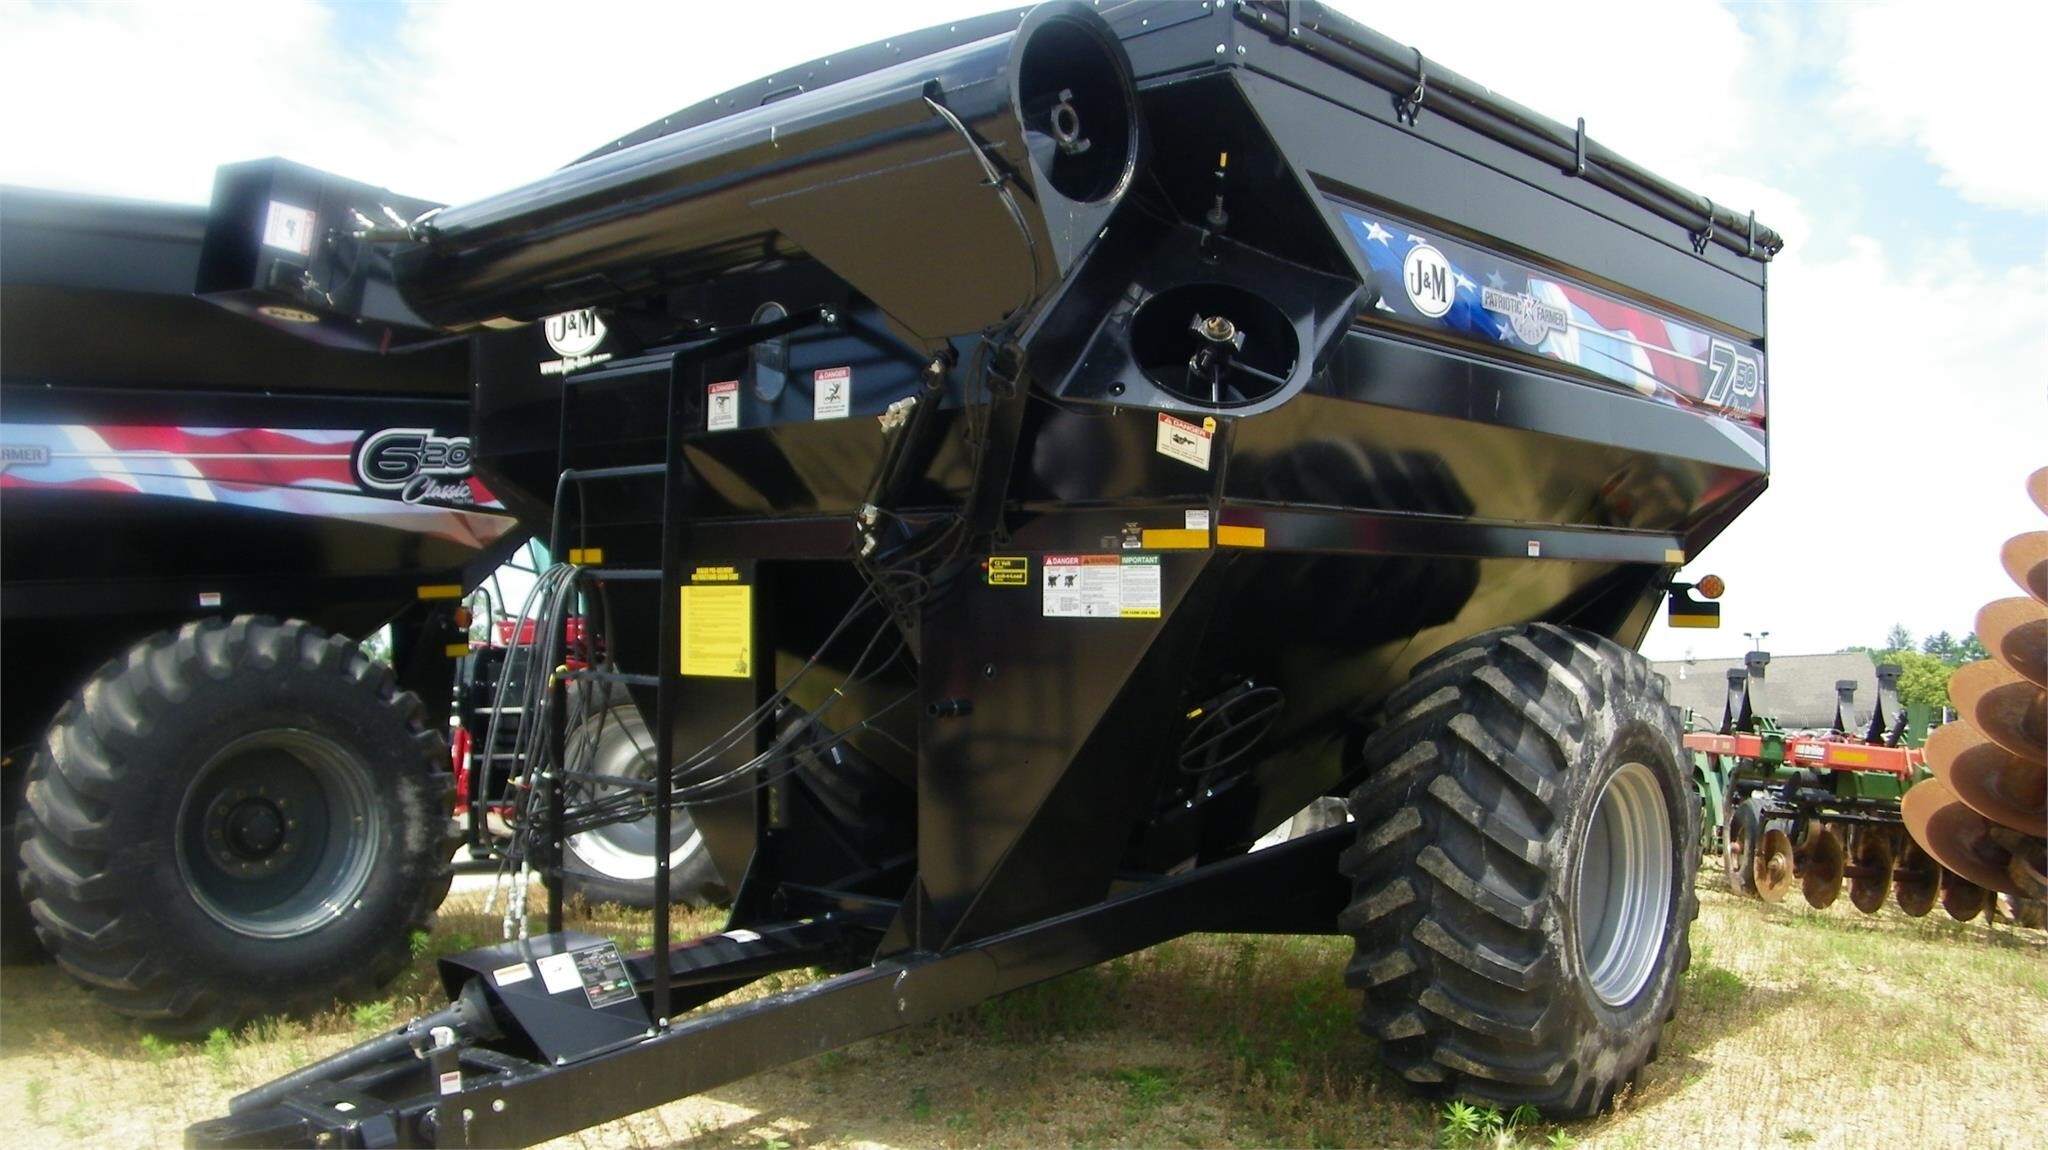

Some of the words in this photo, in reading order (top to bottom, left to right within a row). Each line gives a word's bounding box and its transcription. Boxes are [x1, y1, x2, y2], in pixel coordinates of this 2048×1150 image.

[1410, 259, 1447, 303] J&M
[1484, 290, 1523, 315] PATRIOTIC
[1536, 303, 1564, 327] FARMER
[552, 310, 596, 342] J&M
[824, 368, 847, 380] DANGER
[1703, 338, 1758, 405] 750
[1173, 420, 1206, 436] DANGER
[0, 448, 42, 461] RMER
[357, 427, 471, 490] 620
[402, 474, 471, 505] Classic
[1052, 556, 1079, 565] DANGER
[1121, 556, 1159, 564] IMPORTANT
